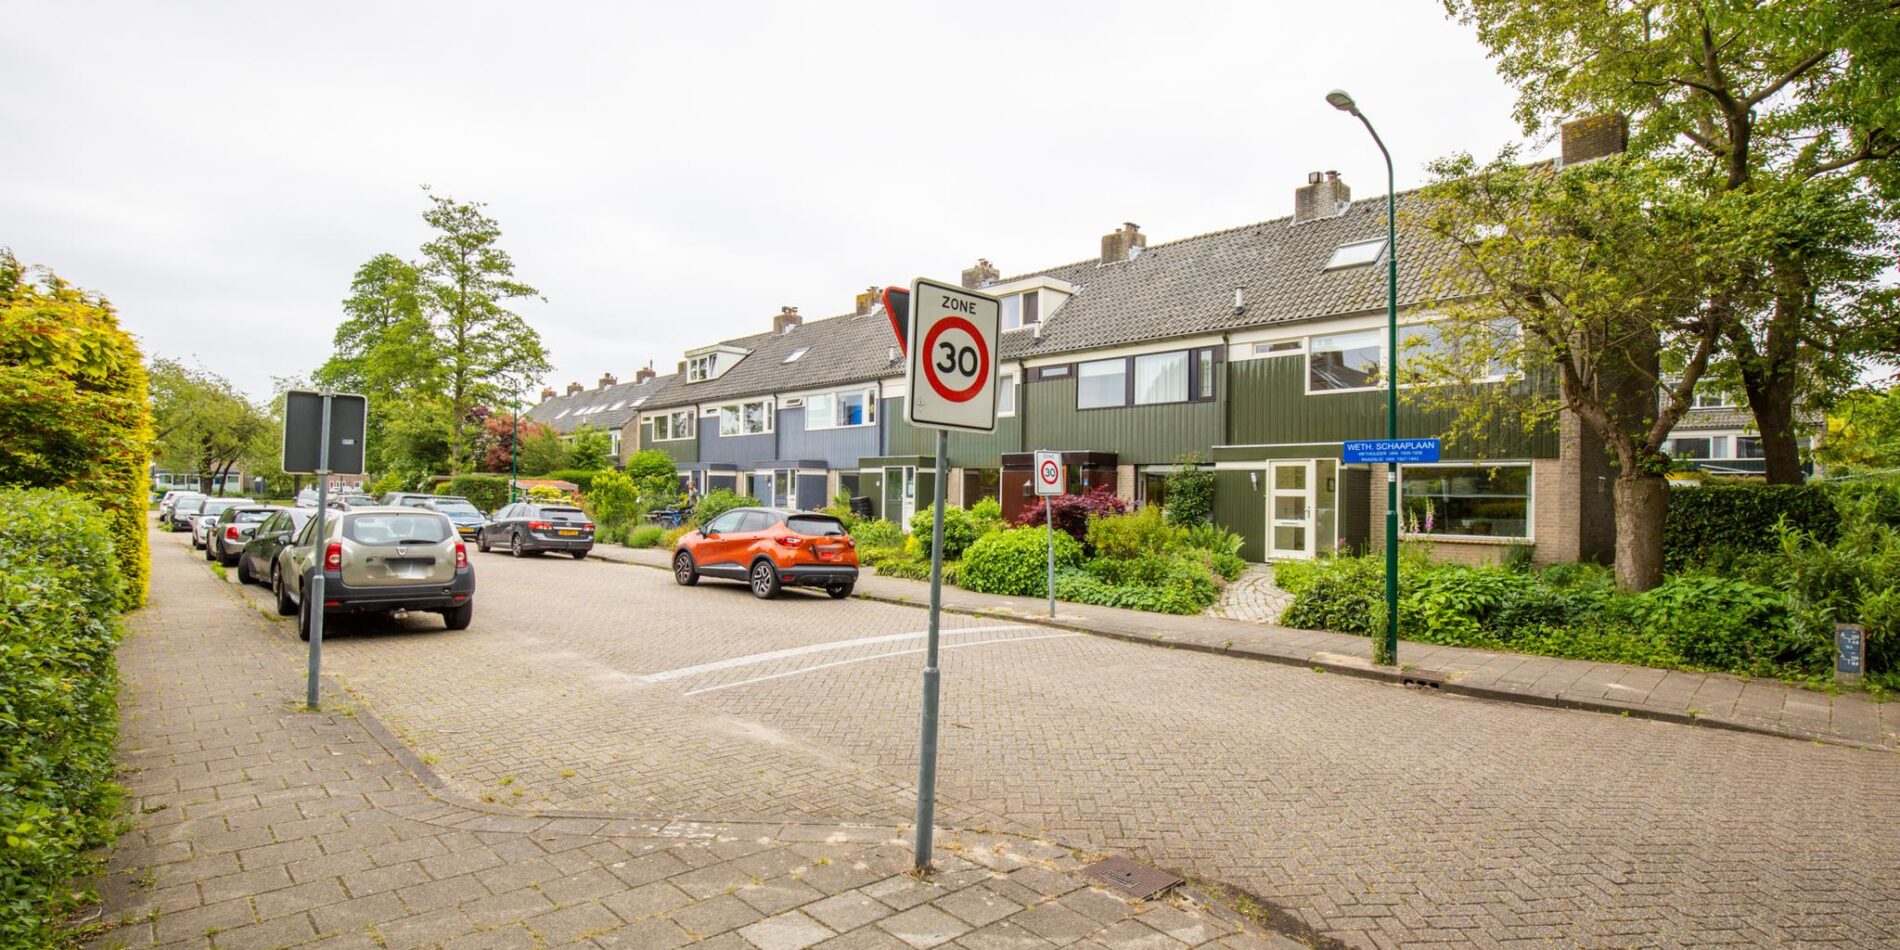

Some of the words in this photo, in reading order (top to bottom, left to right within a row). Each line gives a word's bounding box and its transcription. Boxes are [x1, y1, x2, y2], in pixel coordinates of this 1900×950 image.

[942, 295, 977, 315] ZONE
[936, 341, 978, 378] 30
[1347, 443, 1374, 451] WETH.
[1376, 441, 1435, 451] SCHAAPLAAN
[1045, 467, 1056, 477] 30
